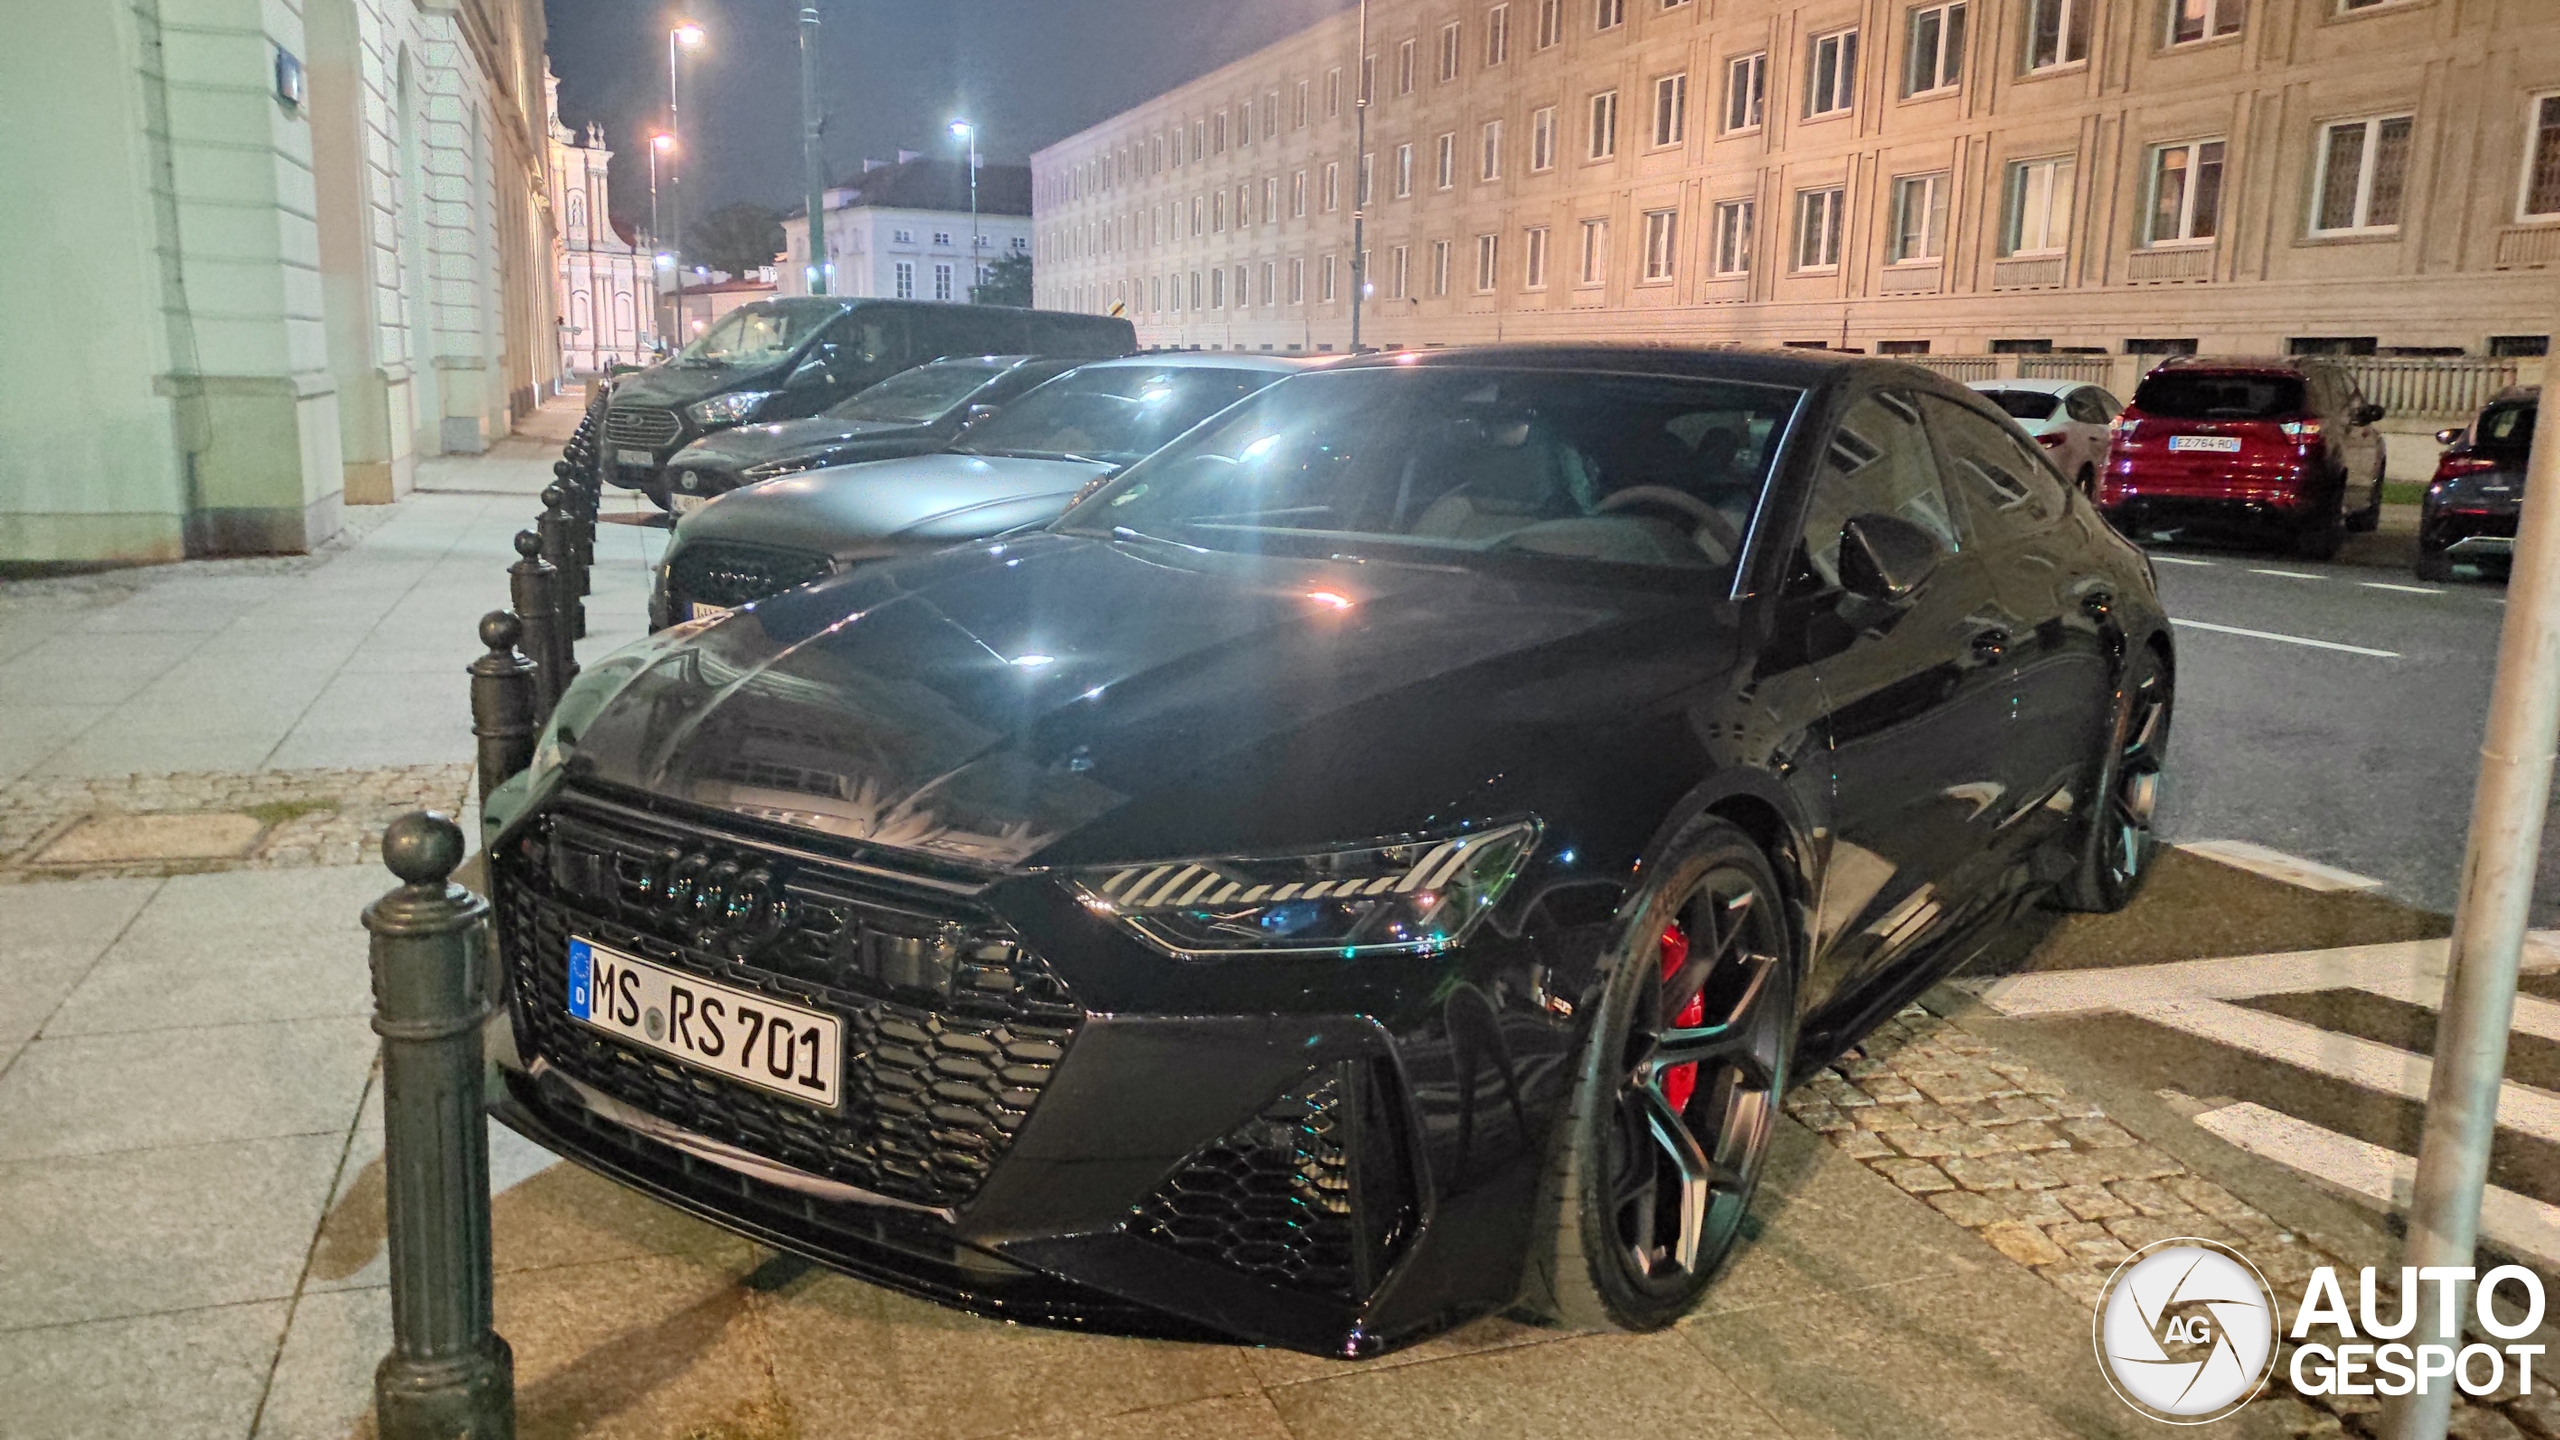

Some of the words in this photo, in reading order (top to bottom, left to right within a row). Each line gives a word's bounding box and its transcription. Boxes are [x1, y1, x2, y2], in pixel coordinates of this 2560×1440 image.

[575, 986, 586, 1006] D
[592, 956, 641, 1027] MS
[669, 984, 726, 1057] RS
[737, 1005, 827, 1092] 701
